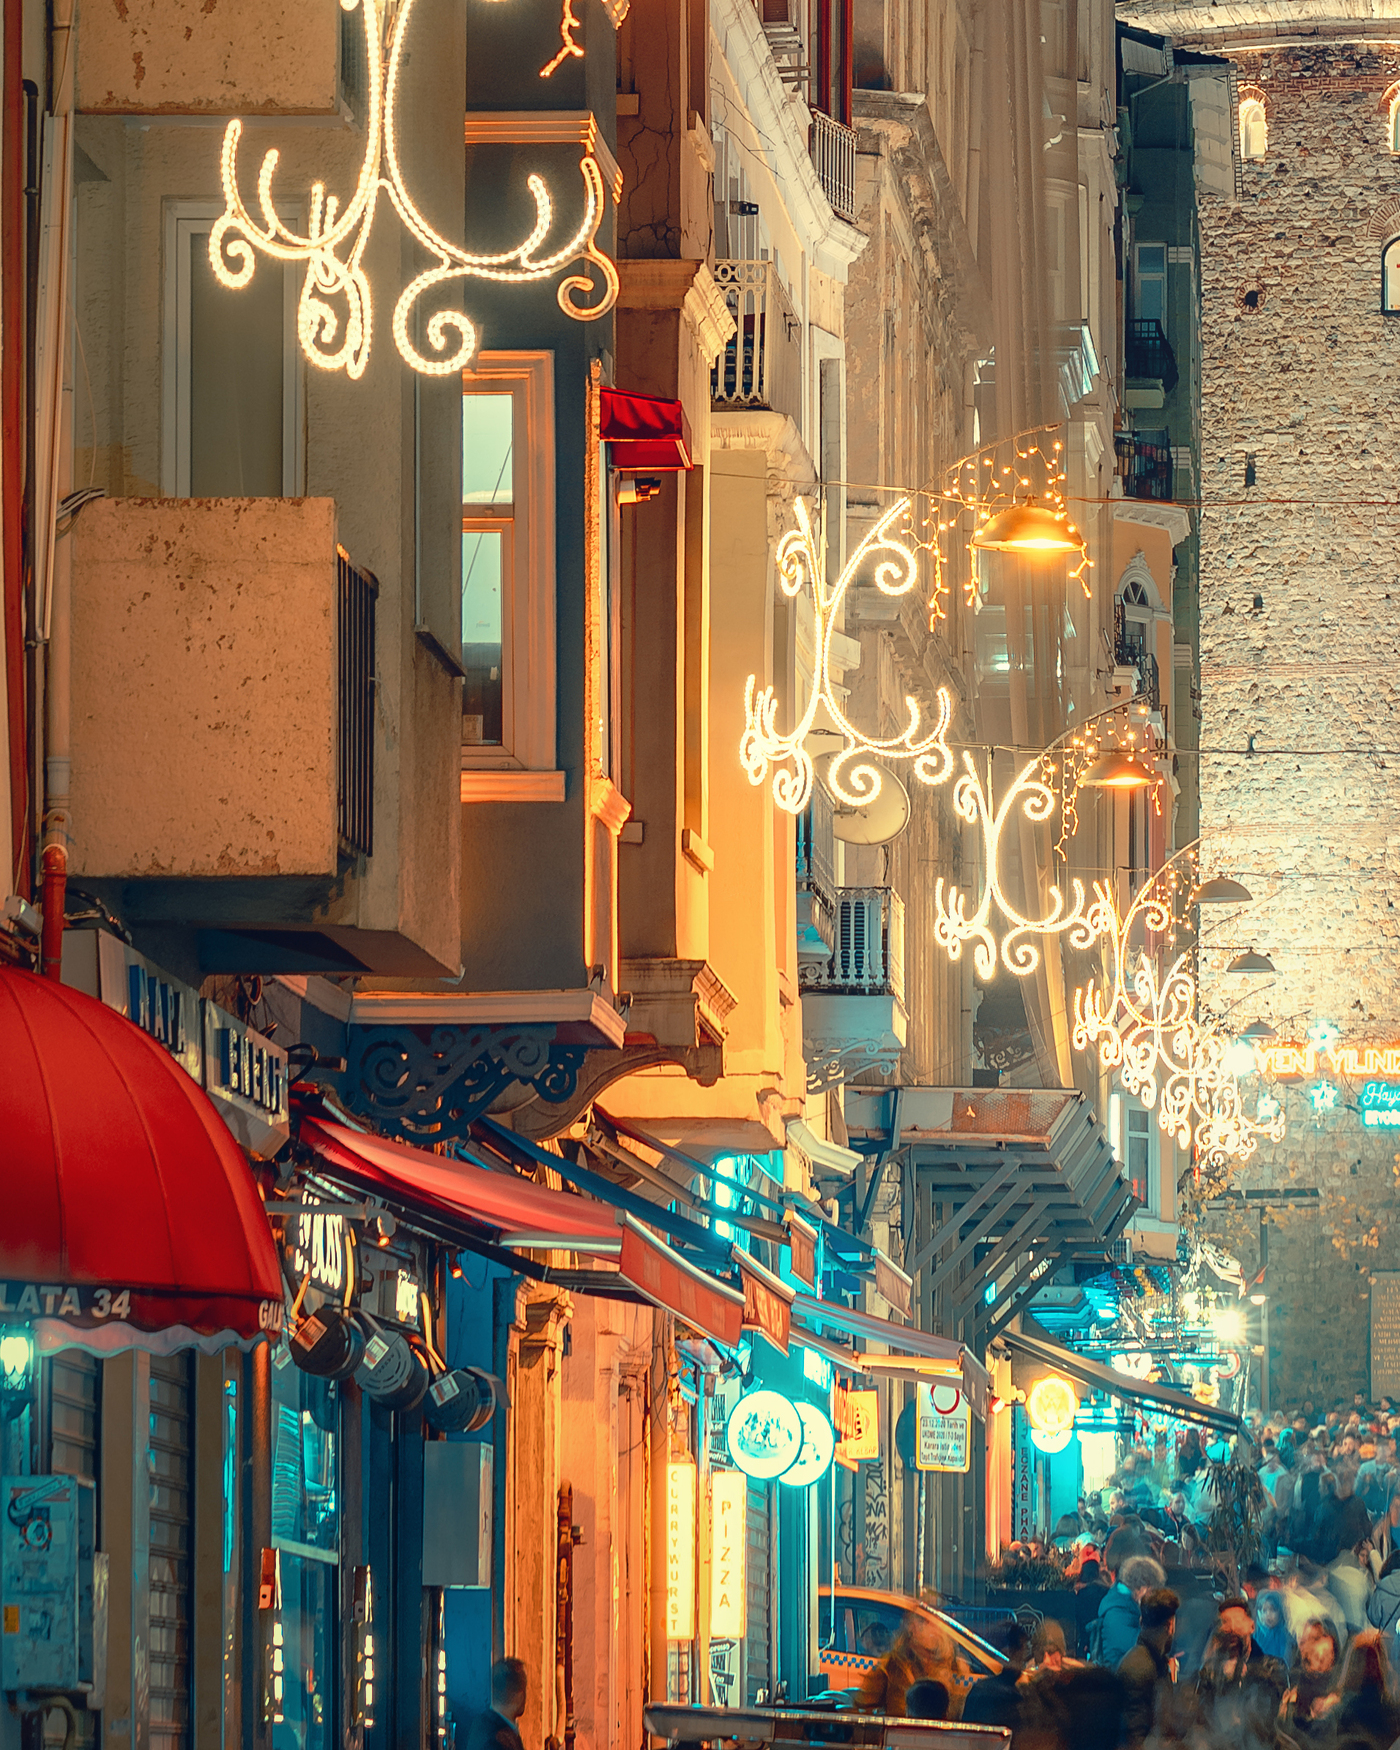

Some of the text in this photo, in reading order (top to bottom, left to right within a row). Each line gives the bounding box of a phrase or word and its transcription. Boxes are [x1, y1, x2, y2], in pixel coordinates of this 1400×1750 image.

[0, 1284, 131, 1319] LATA 34
[1020, 1447, 1029, 1502] ECZANE
[669, 1471, 679, 1632] CURRYWURST
[720, 1501, 733, 1608] PIZZA
